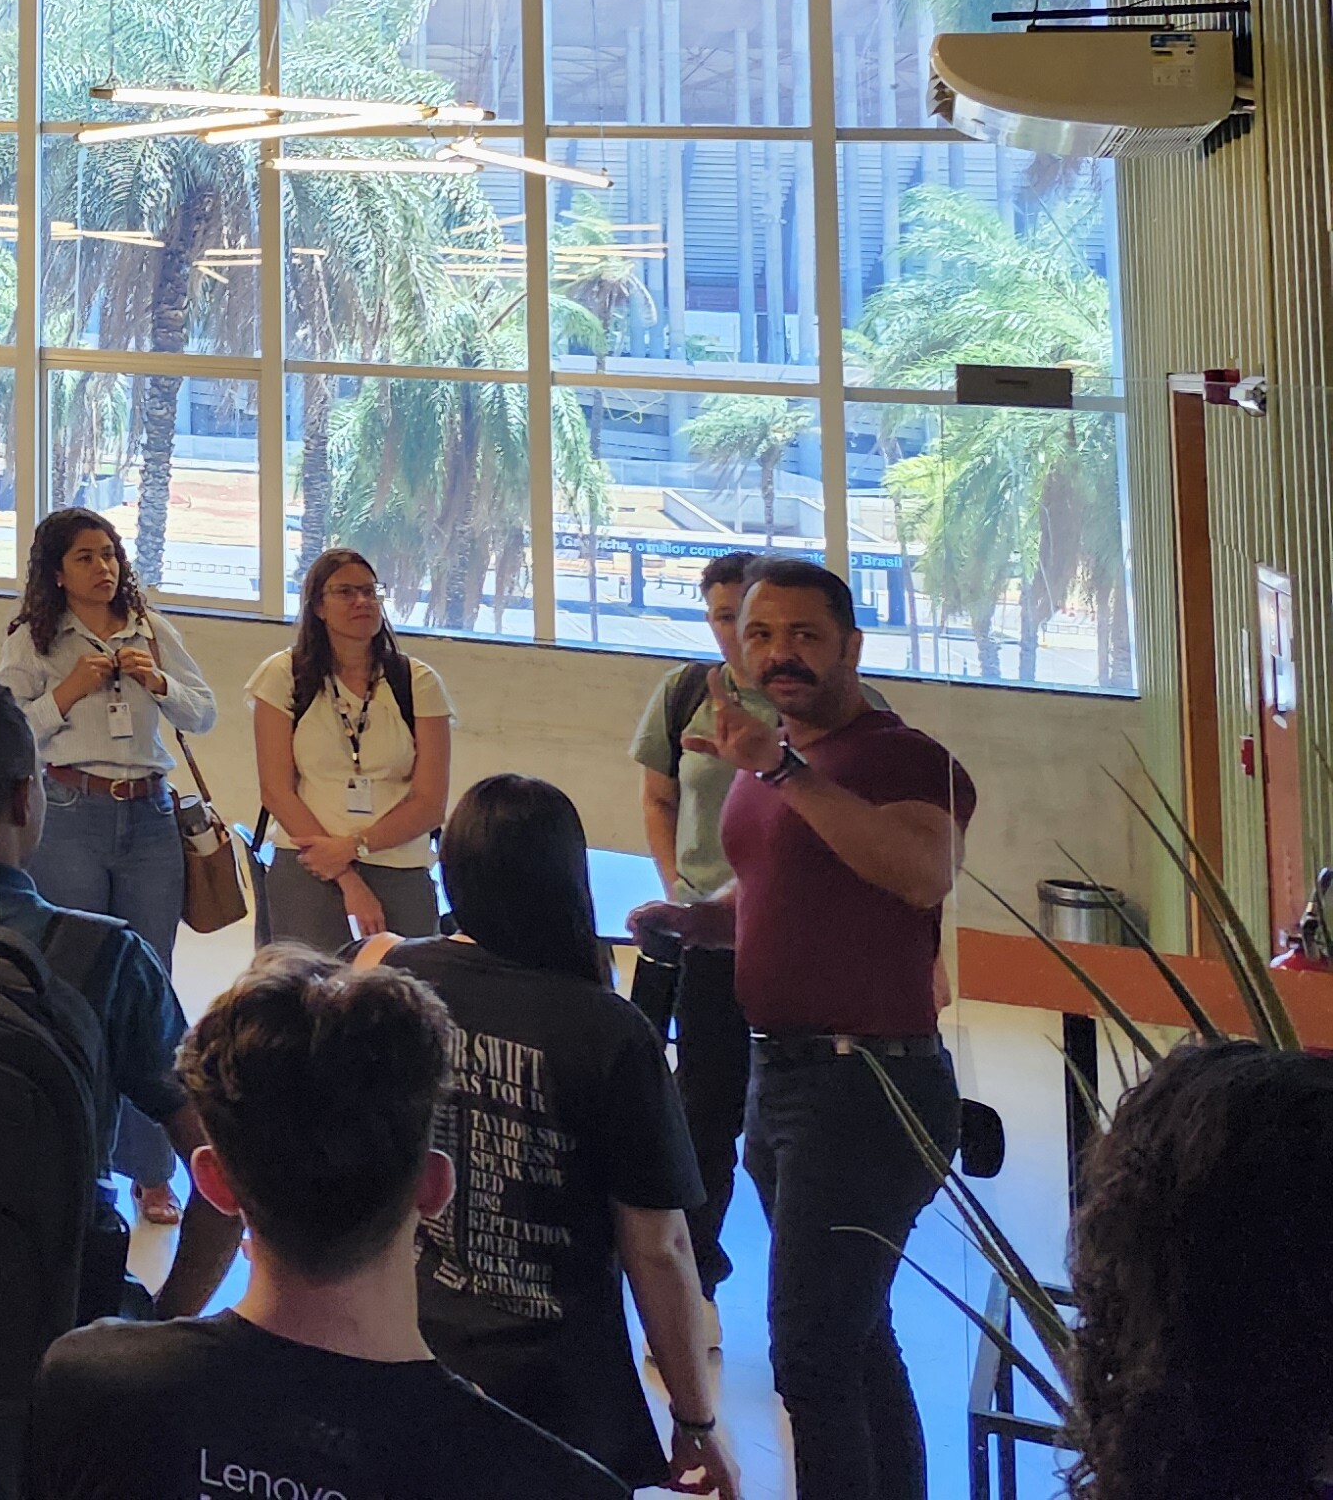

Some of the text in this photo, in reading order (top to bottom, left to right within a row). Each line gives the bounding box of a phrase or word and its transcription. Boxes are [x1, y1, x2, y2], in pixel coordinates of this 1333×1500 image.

[863, 555, 903, 569] Brasil
[474, 1032, 544, 1090] SWIFT
[487, 1078, 546, 1113] TOUR
[470, 1109, 533, 1142] TAYLOR
[469, 1150, 523, 1182] SPEAK
[469, 1171, 505, 1195] RED
[468, 1209, 572, 1247] REPUTATION
[468, 1230, 520, 1258] LOVER
[467, 1250, 553, 1282] FOLKLORE
